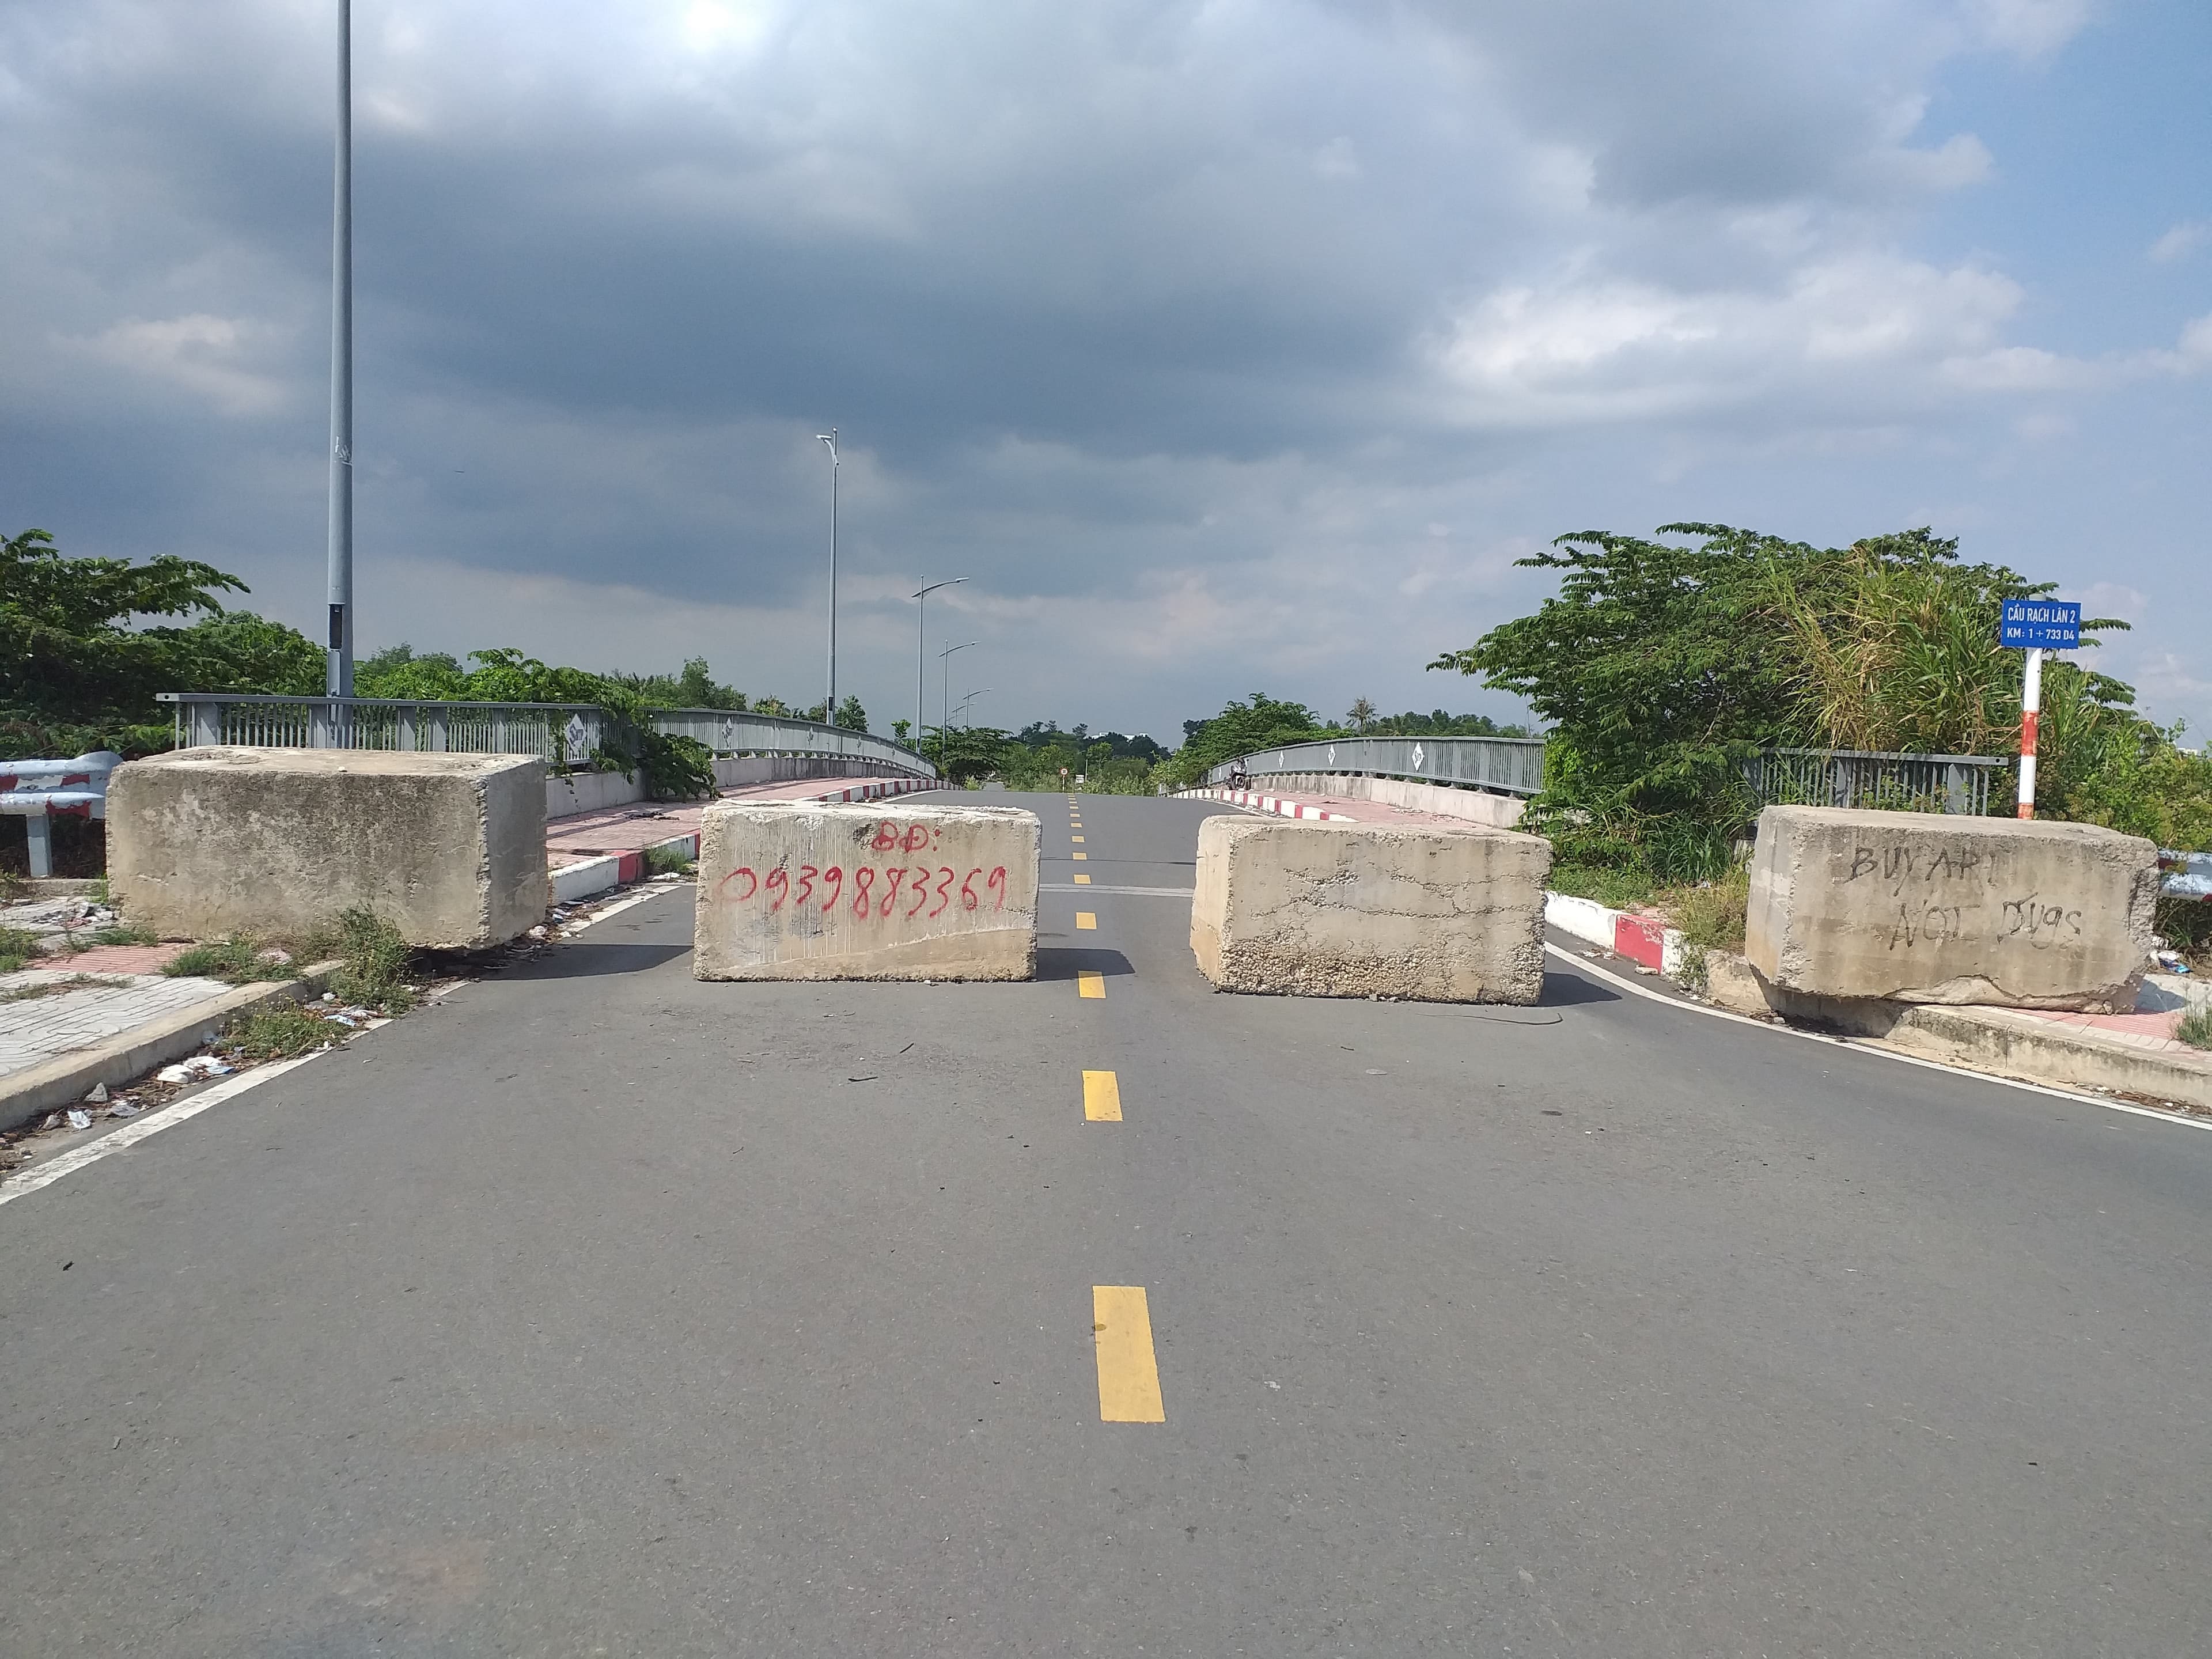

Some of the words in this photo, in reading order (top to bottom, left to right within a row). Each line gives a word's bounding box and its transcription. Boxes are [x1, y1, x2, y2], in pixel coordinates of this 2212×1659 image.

[2007, 627, 2025, 638] KM:
[2028, 628, 2033, 639] 1
[2046, 629, 2061, 640] 733
[2063, 630, 2075, 641] D4
[2027, 607, 2049, 624] RẠCH
[2051, 607, 2068, 623] LÂN
[2070, 609, 2075, 623] 2
[716, 866, 1006, 919] 0939883369
[1842, 845, 1920, 897] BUY
[1889, 899, 1980, 950] NOT
